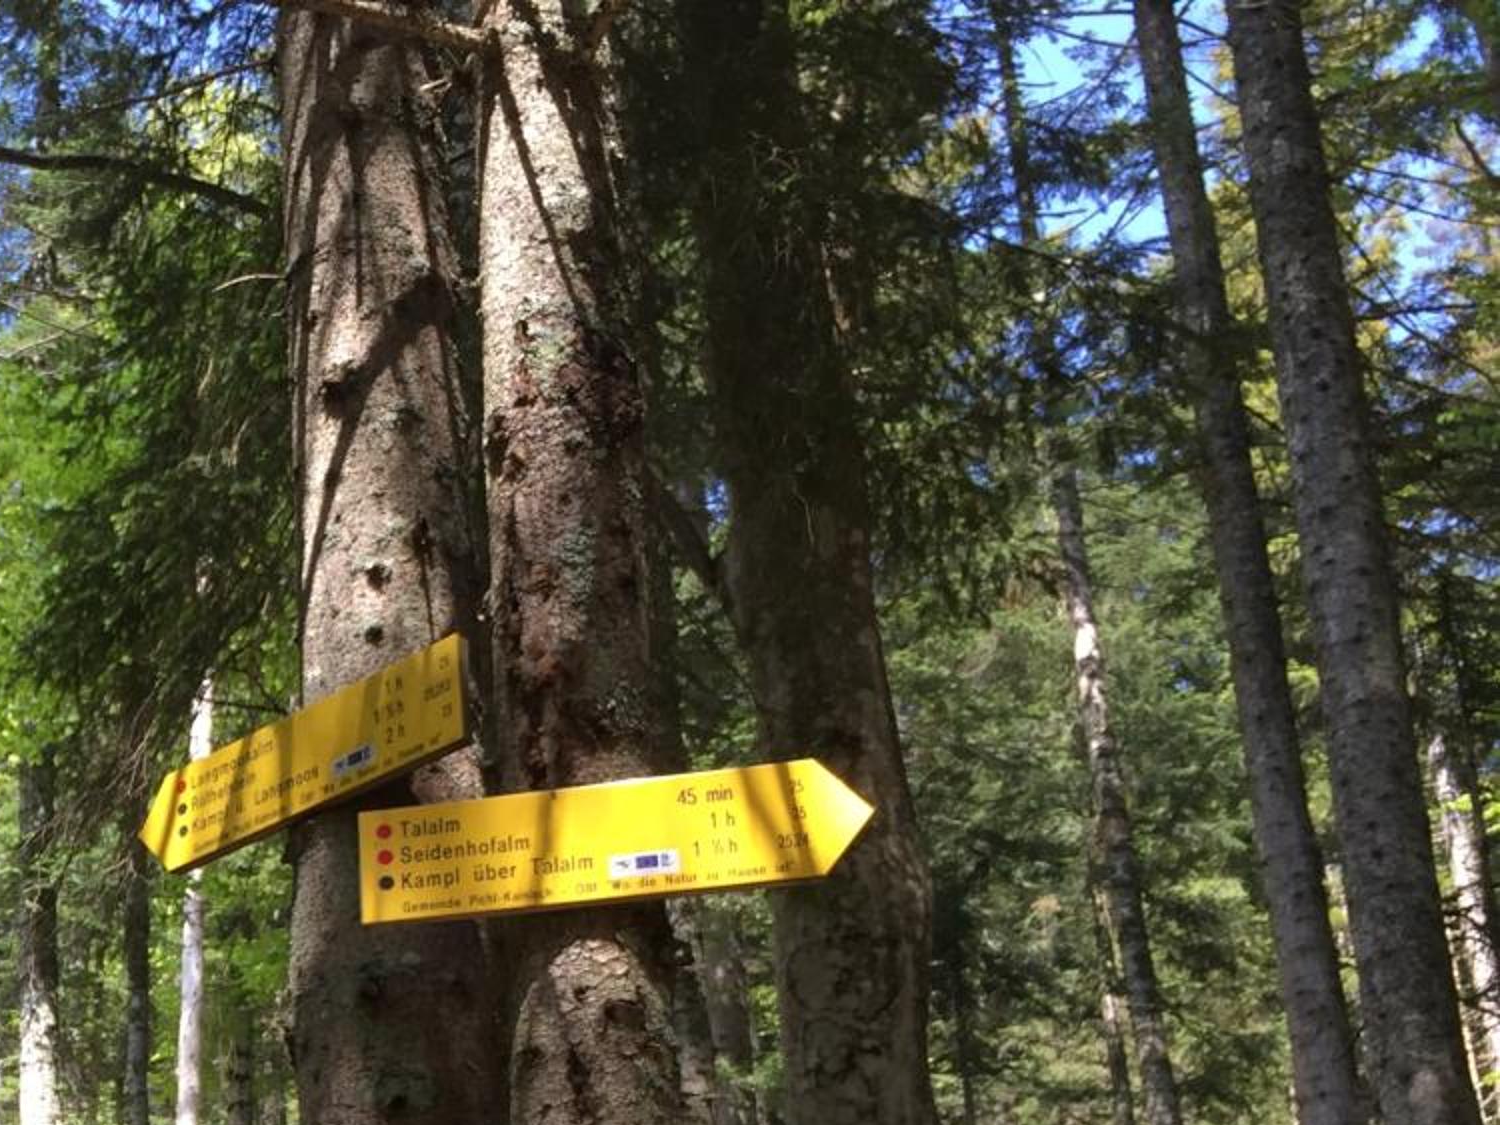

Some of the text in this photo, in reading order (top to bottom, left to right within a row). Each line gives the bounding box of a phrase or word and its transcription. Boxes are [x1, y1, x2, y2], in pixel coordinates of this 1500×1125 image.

[401, 818, 461, 837] Talalm
[677, 788, 698, 805] 45
[706, 784, 734, 803] min
[401, 836, 531, 864] Seidenhofalm
[725, 809, 736, 827] h
[401, 868, 461, 890] Kampl
[473, 863, 517, 883] über
[532, 856, 594, 876] Talalm
[728, 837, 738, 854] h
